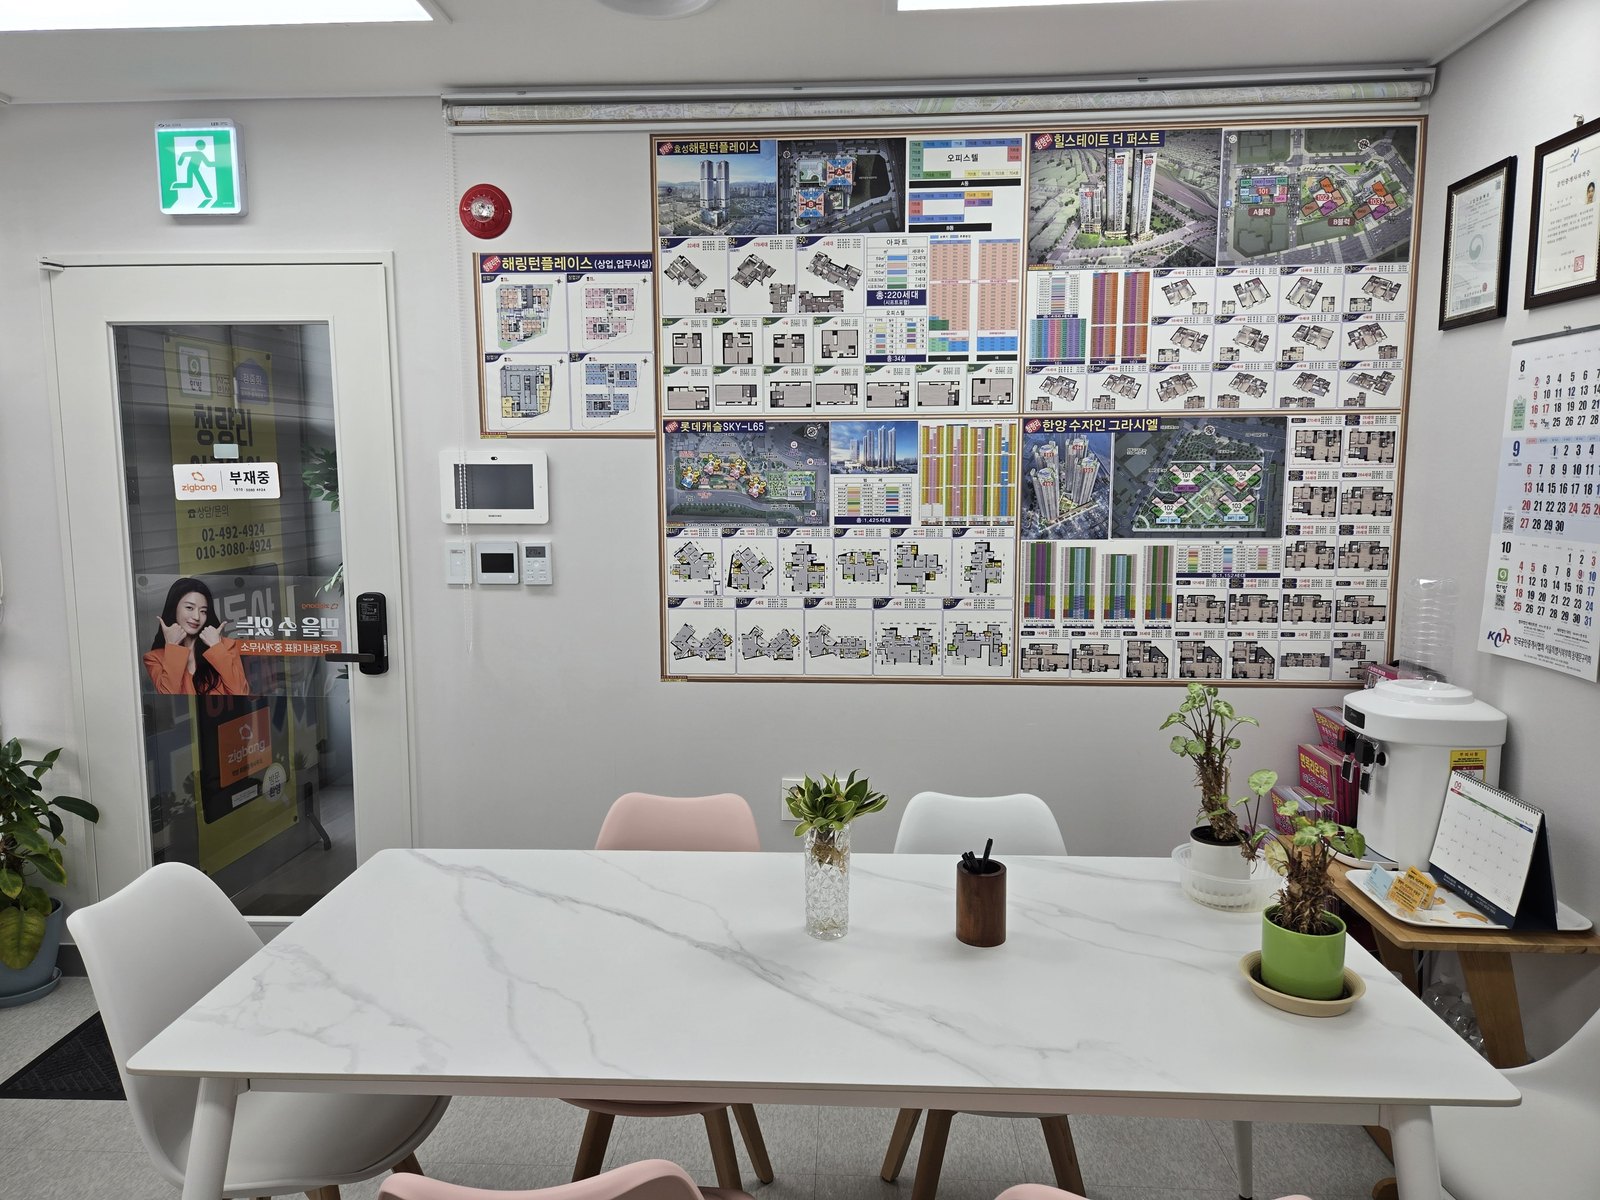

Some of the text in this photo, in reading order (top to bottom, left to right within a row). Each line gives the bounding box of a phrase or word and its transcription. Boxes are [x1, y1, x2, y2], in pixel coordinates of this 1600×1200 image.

[1034, 132, 1160, 149] 청량리 힐스테이트 더 퍼스트
[674, 142, 758, 154] 효성해링턴플레이스
[947, 154, 978, 162] 오피스텔
[502, 256, 593, 271] 해링턴플레이스
[594, 259, 652, 270] (상업,업무시설)
[876, 291, 919, 300] 총:220세대
[1520, 360, 1525, 372] 8
[1535, 377, 1539, 386] 2
[1546, 375, 1550, 384] 3
[1557, 373, 1562, 383] 4
[1571, 372, 1575, 382] 5
[1583, 370, 1588, 380] 6
[1534, 384, 1600, 400] 9 10 11 12 13 14
[1531, 400, 1600, 414] 16 17 18 19 20 21
[680, 420, 764, 432] 롯데캐슬SKY-L65
[1025, 418, 1158, 433] 청량리 한양 수자인 그라시엘
[1552, 414, 1599, 427] 25 26 27 28
[1513, 441, 1520, 456] 9
[1553, 444, 1594, 456] 1 2 3 4
[1527, 464, 1594, 475] 6 7 8 9 10 11
[182, 470, 270, 493] zigbang 부재중
[1524, 482, 1532, 492] 13
[1536, 483, 1544, 493] 14
[1548, 483, 1556, 494] 15
[1560, 483, 1568, 494] 16
[1571, 483, 1580, 494] 17
[1584, 484, 1592, 495] 18
[197, 505, 229, 519] 상담/문의
[1522, 500, 1530, 510] 20
[1534, 501, 1542, 511] 21
[1546, 501, 1554, 512] 22
[1557, 502, 1566, 512] 23
[1569, 502, 1578, 513] 24
[1581, 503, 1590, 514] 25
[1520, 518, 1564, 532] 27 28 29 30
[202, 524, 265, 542] 02-492-4924
[196, 538, 272, 560] 010-3080-4924
[1502, 542, 1511, 553] 10
[1568, 554, 1596, 566] 1 2 3
[1519, 561, 1597, 581] 4 5 6 7 8 9 10
[1517, 575, 1595, 596] 11 12 13 14 15 16 17
[1515, 588, 1594, 612] 18 19 20 21 22 23 24
[1513, 602, 1592, 626] 25 26 27 28 29 30 31
[227, 740, 266, 763] zigbang
